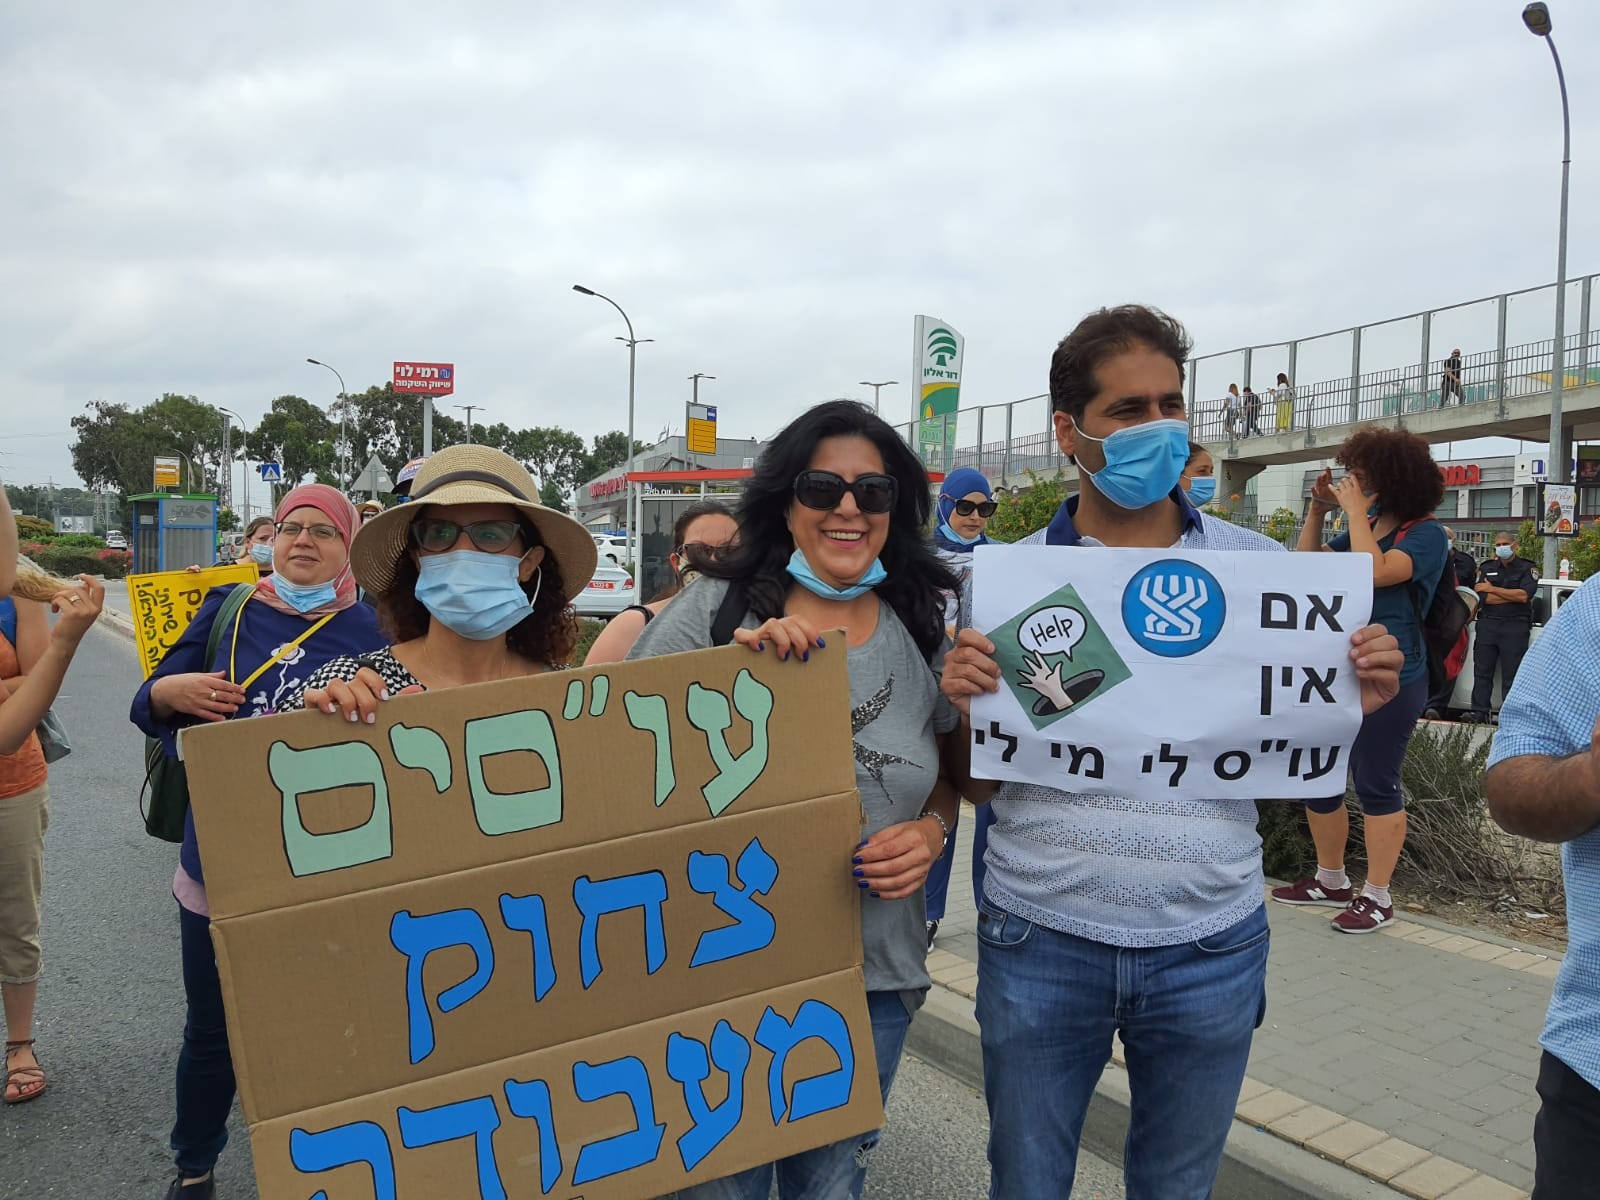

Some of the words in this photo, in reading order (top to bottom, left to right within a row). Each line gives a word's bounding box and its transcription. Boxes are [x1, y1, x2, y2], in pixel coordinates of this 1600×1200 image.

[395, 364, 414, 377] לוי
[395, 379, 427, 389] השקמה
[416, 366, 439, 378] רמי
[428, 381, 451, 390] שיווק
[923, 367, 944, 378] אלון
[945, 370, 958, 380] דור
[1030, 614, 1073, 648] Help
[1260, 592, 1344, 633] אם
[1260, 665, 1338, 716] אין
[975, 721, 1018, 763] לי
[1050, 742, 1105, 780] מי
[1213, 739, 1342, 781] עו"ס
[1141, 743, 1188, 788] לי
[389, 836, 779, 1065] צחוק
[289, 999, 855, 1200] מעבודה
